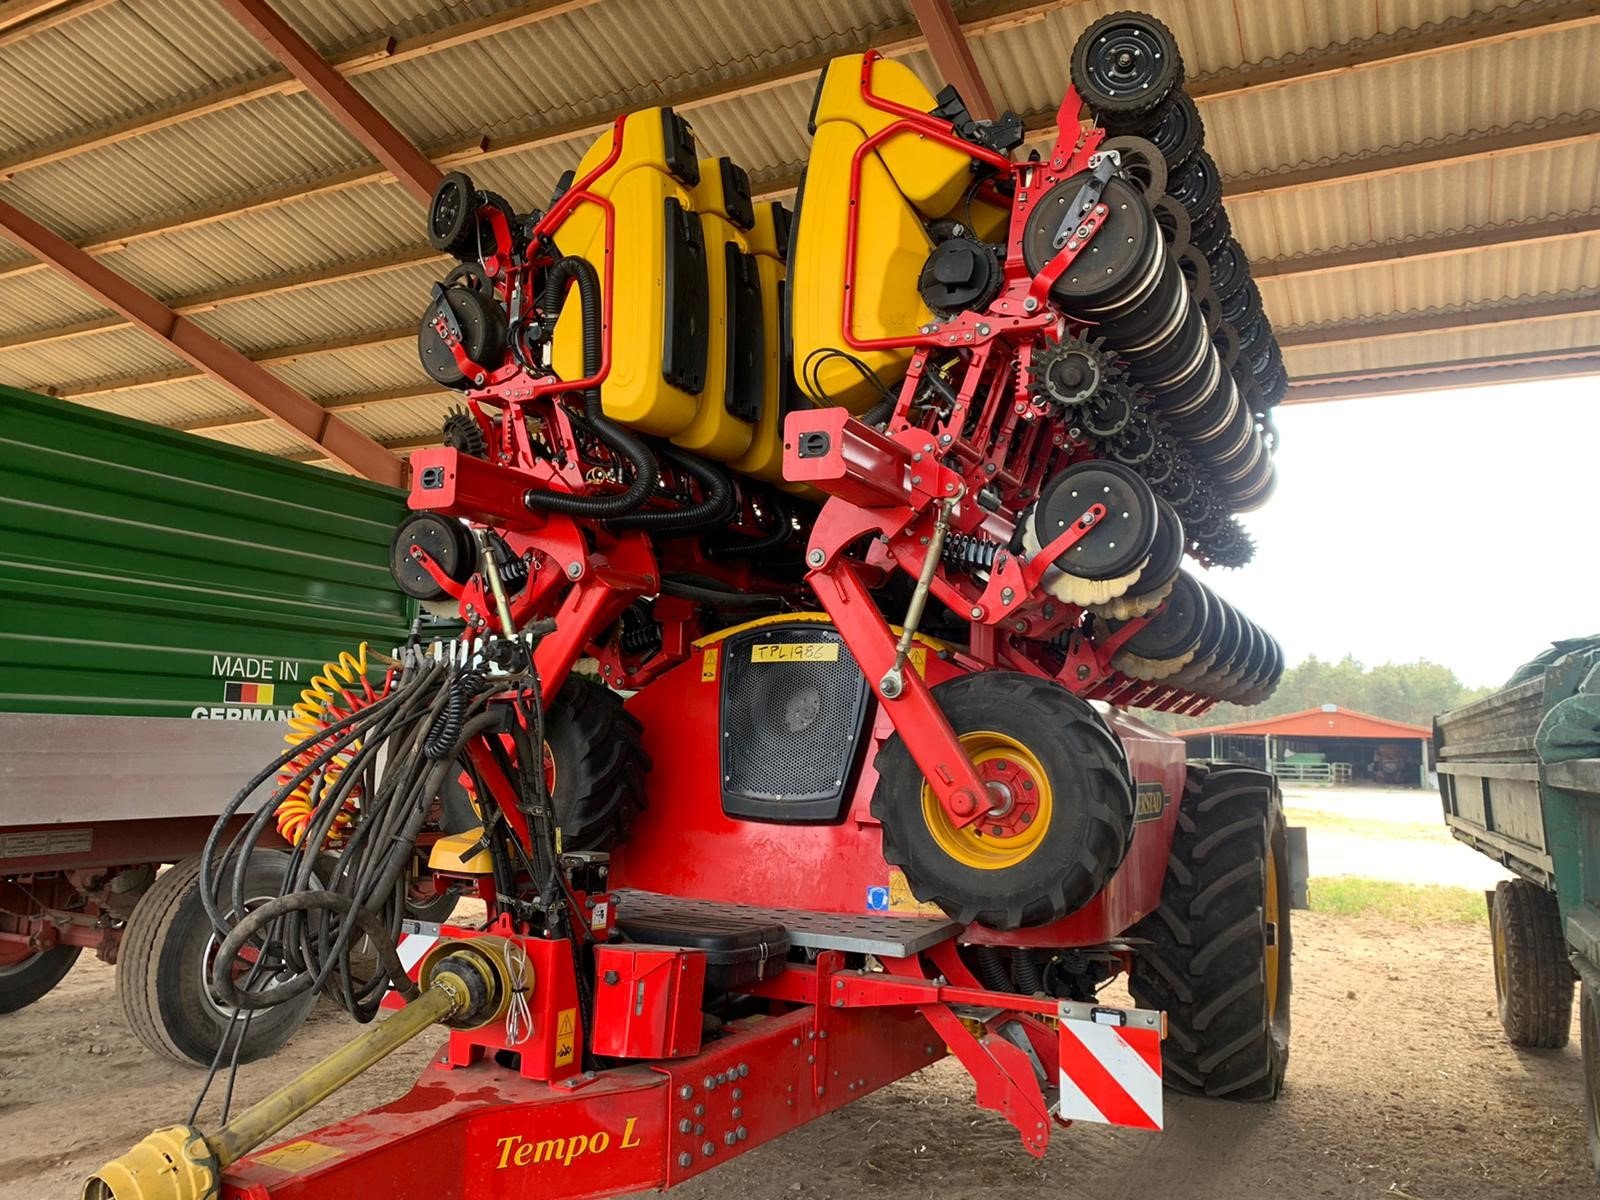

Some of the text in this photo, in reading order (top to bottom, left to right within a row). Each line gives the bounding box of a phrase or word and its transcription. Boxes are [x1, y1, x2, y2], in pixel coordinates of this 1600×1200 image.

[212, 655, 299, 681] MADE IN
[496, 1116, 641, 1169] Tempo L
